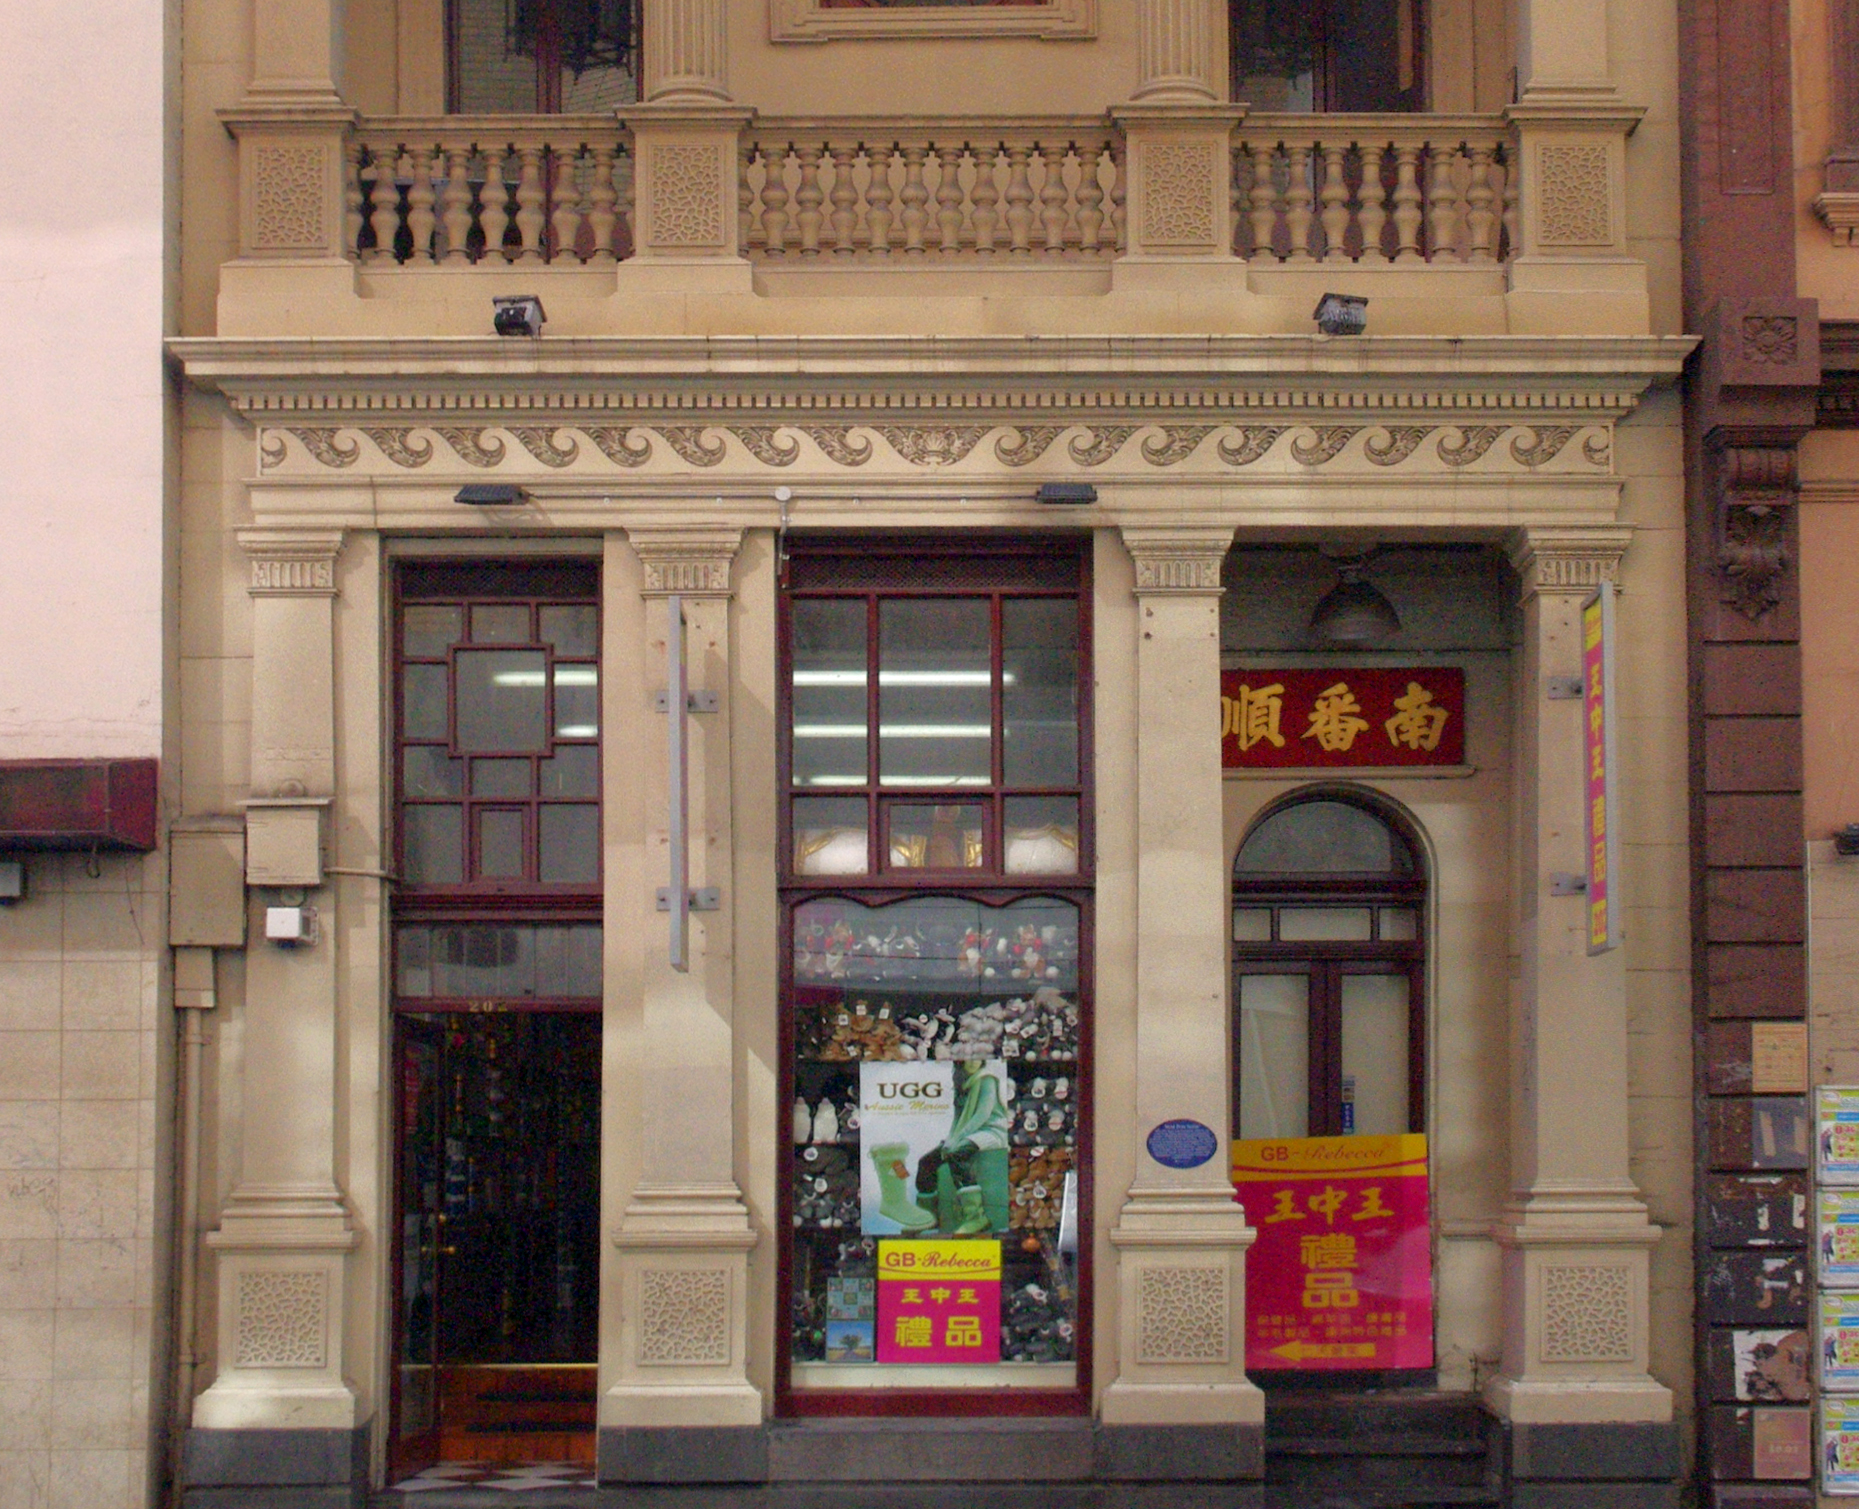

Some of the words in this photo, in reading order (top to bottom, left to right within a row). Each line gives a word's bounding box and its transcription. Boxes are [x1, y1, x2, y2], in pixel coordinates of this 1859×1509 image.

[877, 1081, 943, 1099] UGG
[866, 1101, 904, 1111] Aussie
[907, 1100, 949, 1111] Merino
[1261, 1146, 1289, 1161] GB
[1304, 1145, 1384, 1160] Rebecca
[1264, 1185, 1395, 1225] 王中王
[901, 1287, 979, 1304] 王中王
[895, 1316, 982, 1348] 禮品
